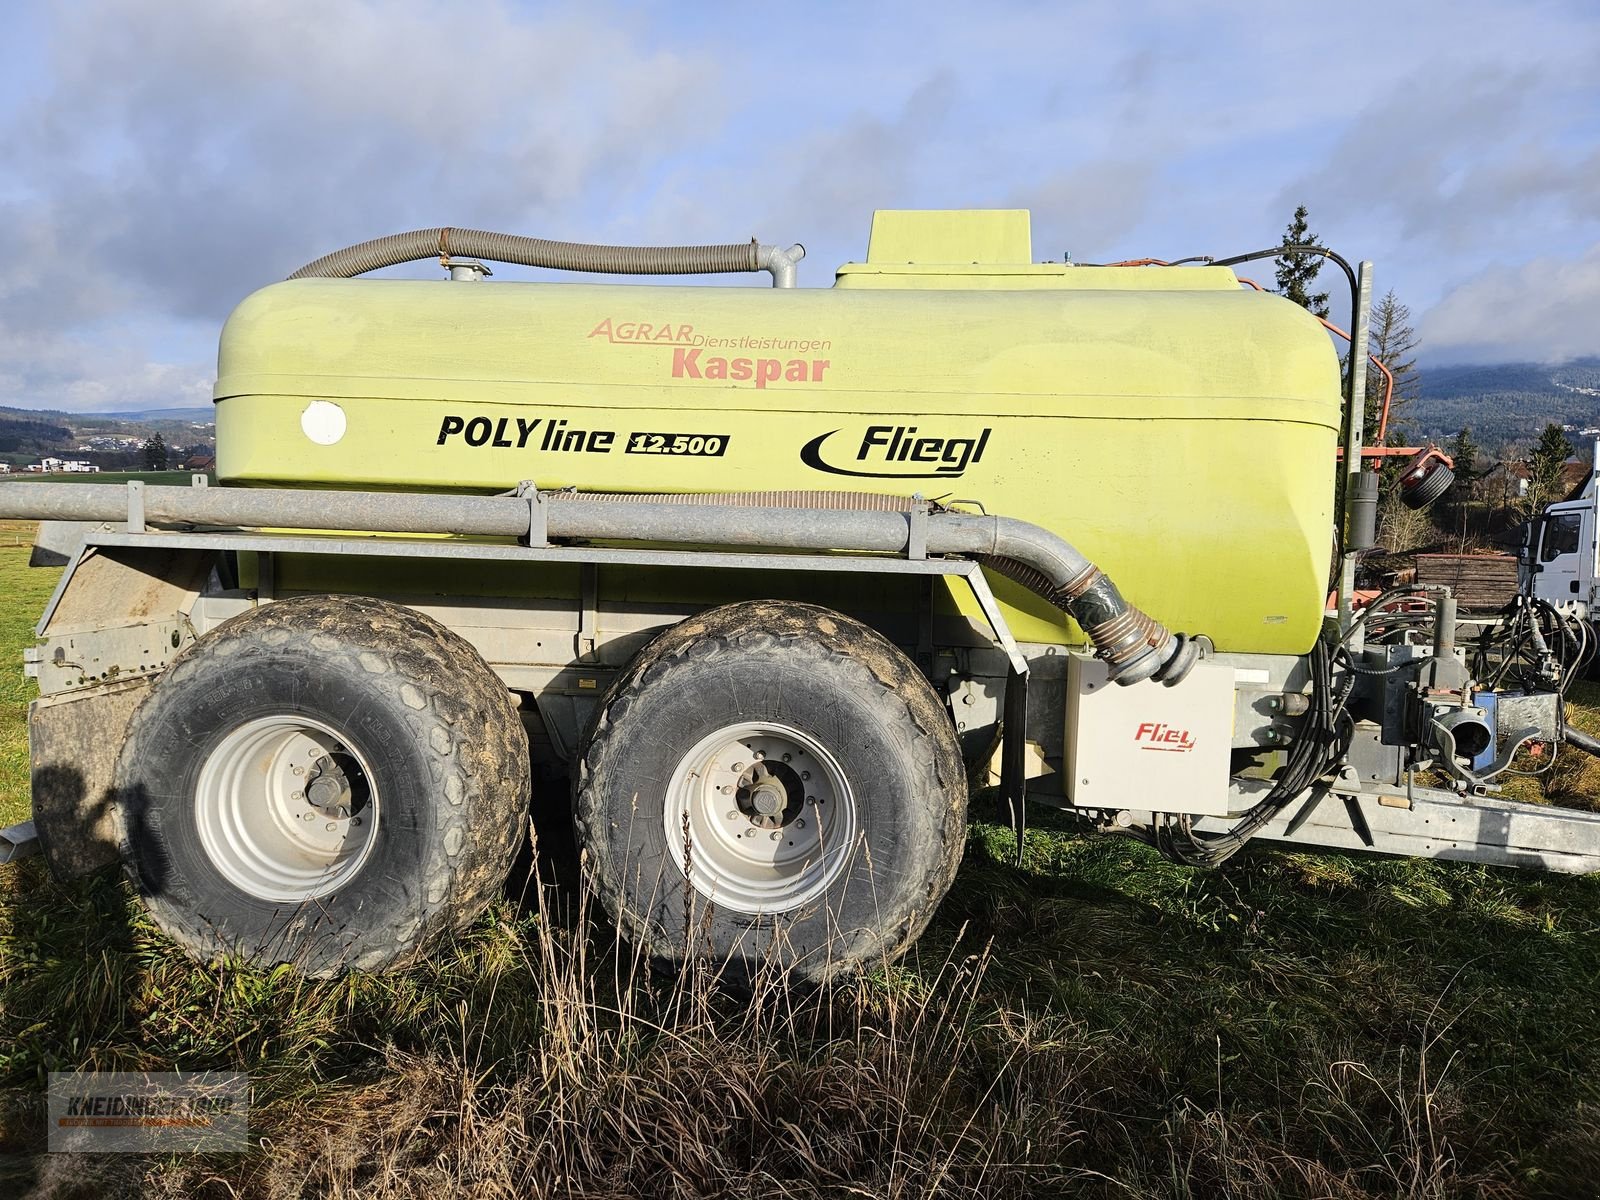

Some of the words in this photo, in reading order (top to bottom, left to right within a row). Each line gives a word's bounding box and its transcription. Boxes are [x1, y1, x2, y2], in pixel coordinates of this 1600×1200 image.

[587, 317, 694, 343] AGRAR
[691, 334, 832, 353] Dienstleistungen
[671, 347, 831, 390] Kaspar
[630, 435, 722, 455] 12.500
[856, 426, 992, 472] Fliegl
